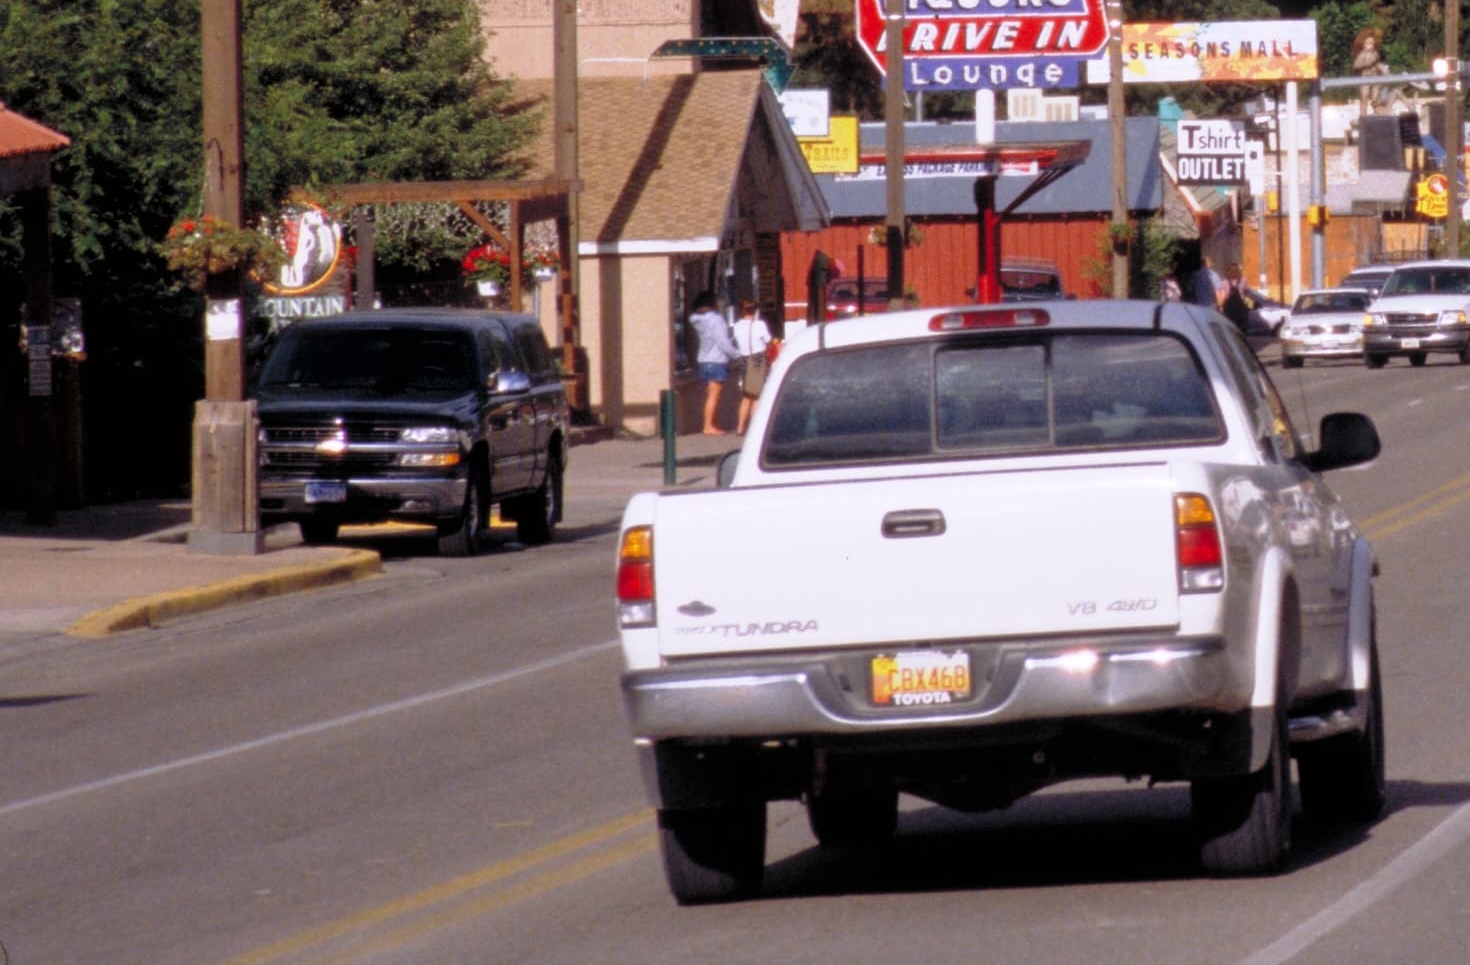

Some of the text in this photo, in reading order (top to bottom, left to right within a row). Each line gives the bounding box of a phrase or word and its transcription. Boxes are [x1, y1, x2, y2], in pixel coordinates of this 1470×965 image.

[1035, 20, 1089, 49] IN
[1129, 38, 1299, 60] SEASONS MALL
[1181, 124, 1242, 150] Tshirt
[1178, 157, 1244, 180] OUTLET
[1066, 598, 1158, 616] V8 4WD
[720, 619, 819, 637] TUNDRA
[892, 691, 952, 706] TOYOTA
